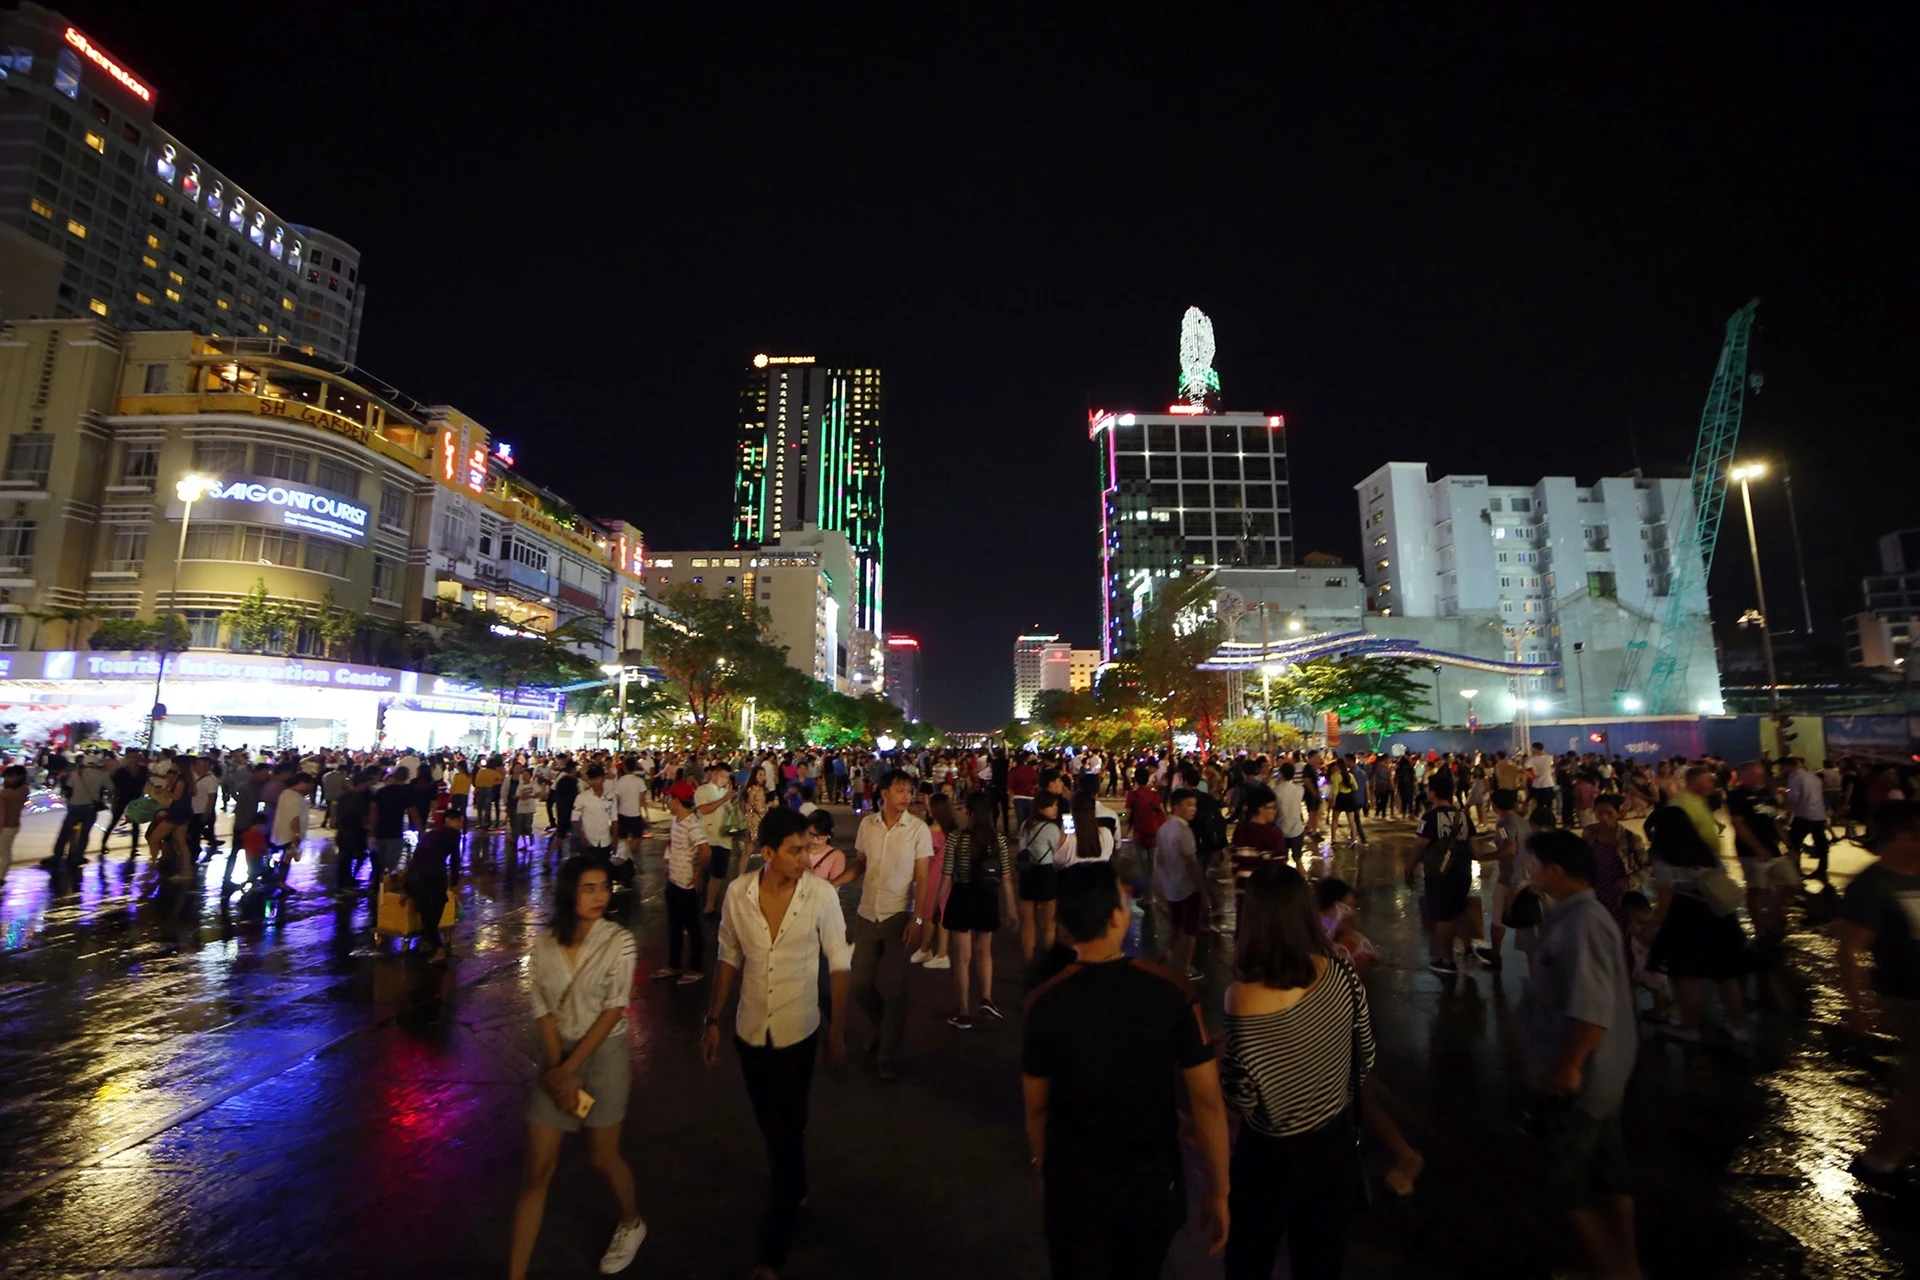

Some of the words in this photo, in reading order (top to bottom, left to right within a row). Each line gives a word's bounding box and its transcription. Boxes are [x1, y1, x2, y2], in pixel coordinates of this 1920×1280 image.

[65, 27, 150, 102] Sheraton
[301, 407, 370, 444] GARDEN
[208, 480, 368, 526] SAIGONTOURIST
[87, 656, 173, 675] Tourist
[178, 658, 330, 682] Information
[334, 667, 392, 687] Center
